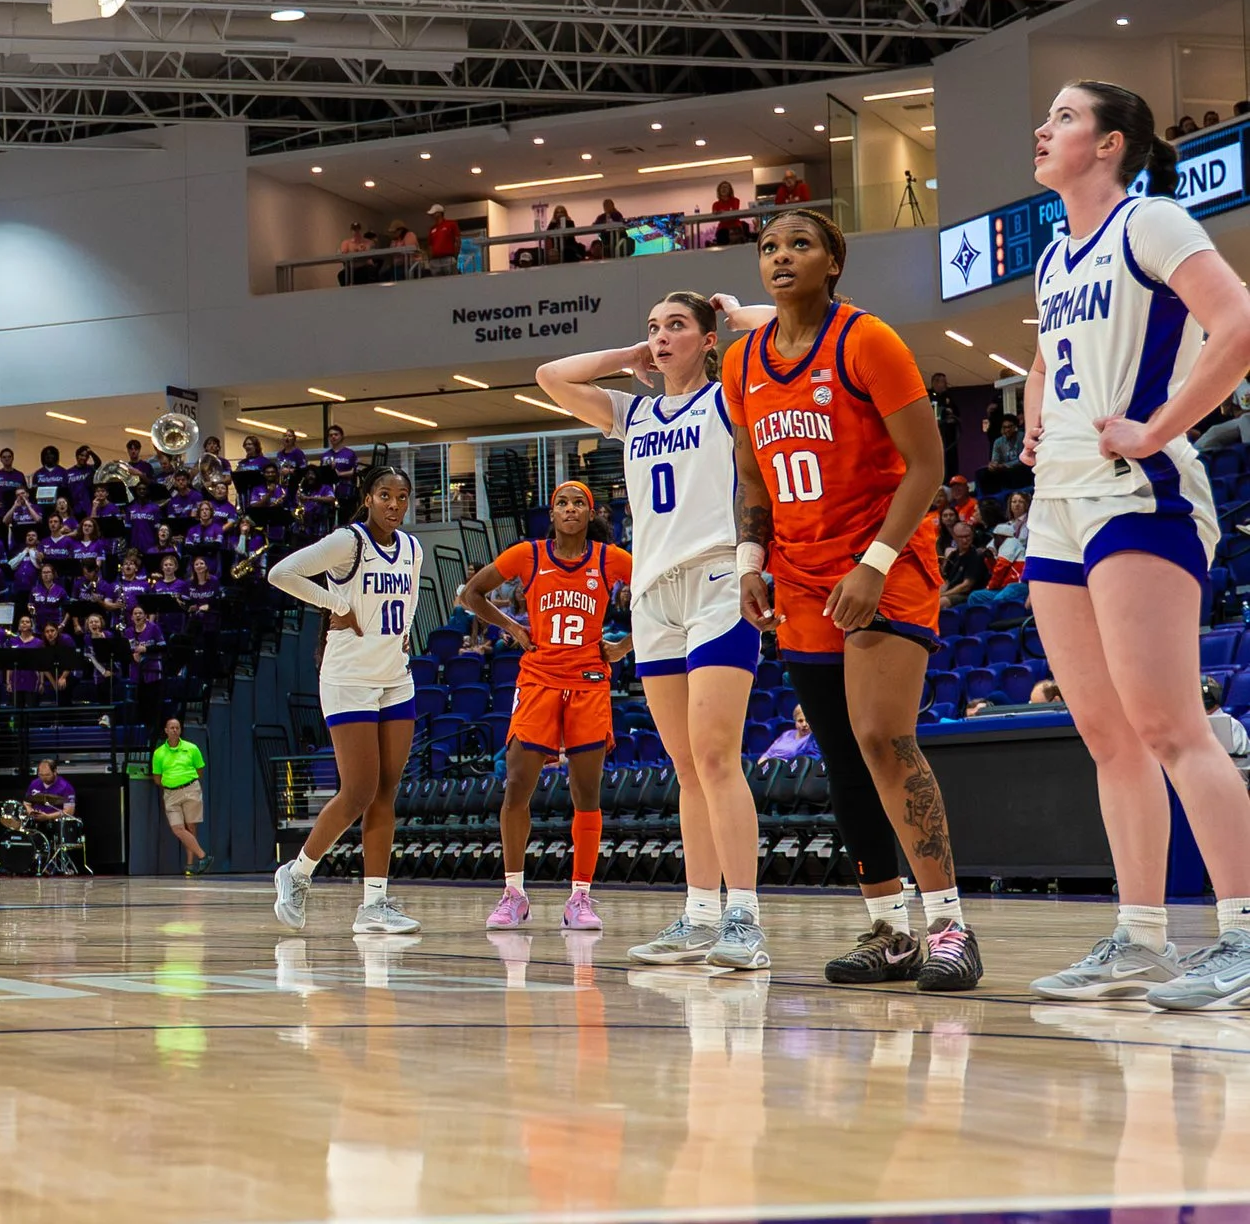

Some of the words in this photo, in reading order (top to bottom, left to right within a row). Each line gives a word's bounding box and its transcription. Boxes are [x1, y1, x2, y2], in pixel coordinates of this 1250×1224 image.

[1177, 159, 1227, 200] 2ND
[1039, 199, 1067, 225] FOU
[452, 304, 532, 325] Newsom
[538, 294, 601, 316] Family
[1040, 279, 1112, 334] URMAN
[475, 325, 522, 343] Suite
[529, 318, 578, 338] Level
[1054, 337, 1081, 403] 2
[630, 425, 701, 461] FURMAN
[754, 410, 834, 450] CLEMSON
[651, 462, 676, 514] 0
[772, 450, 823, 503] 10
[363, 573, 411, 595] FURMA
[381, 599, 405, 635] 10
[540, 590, 596, 615] CLEMSON
[550, 613, 585, 646] 12
